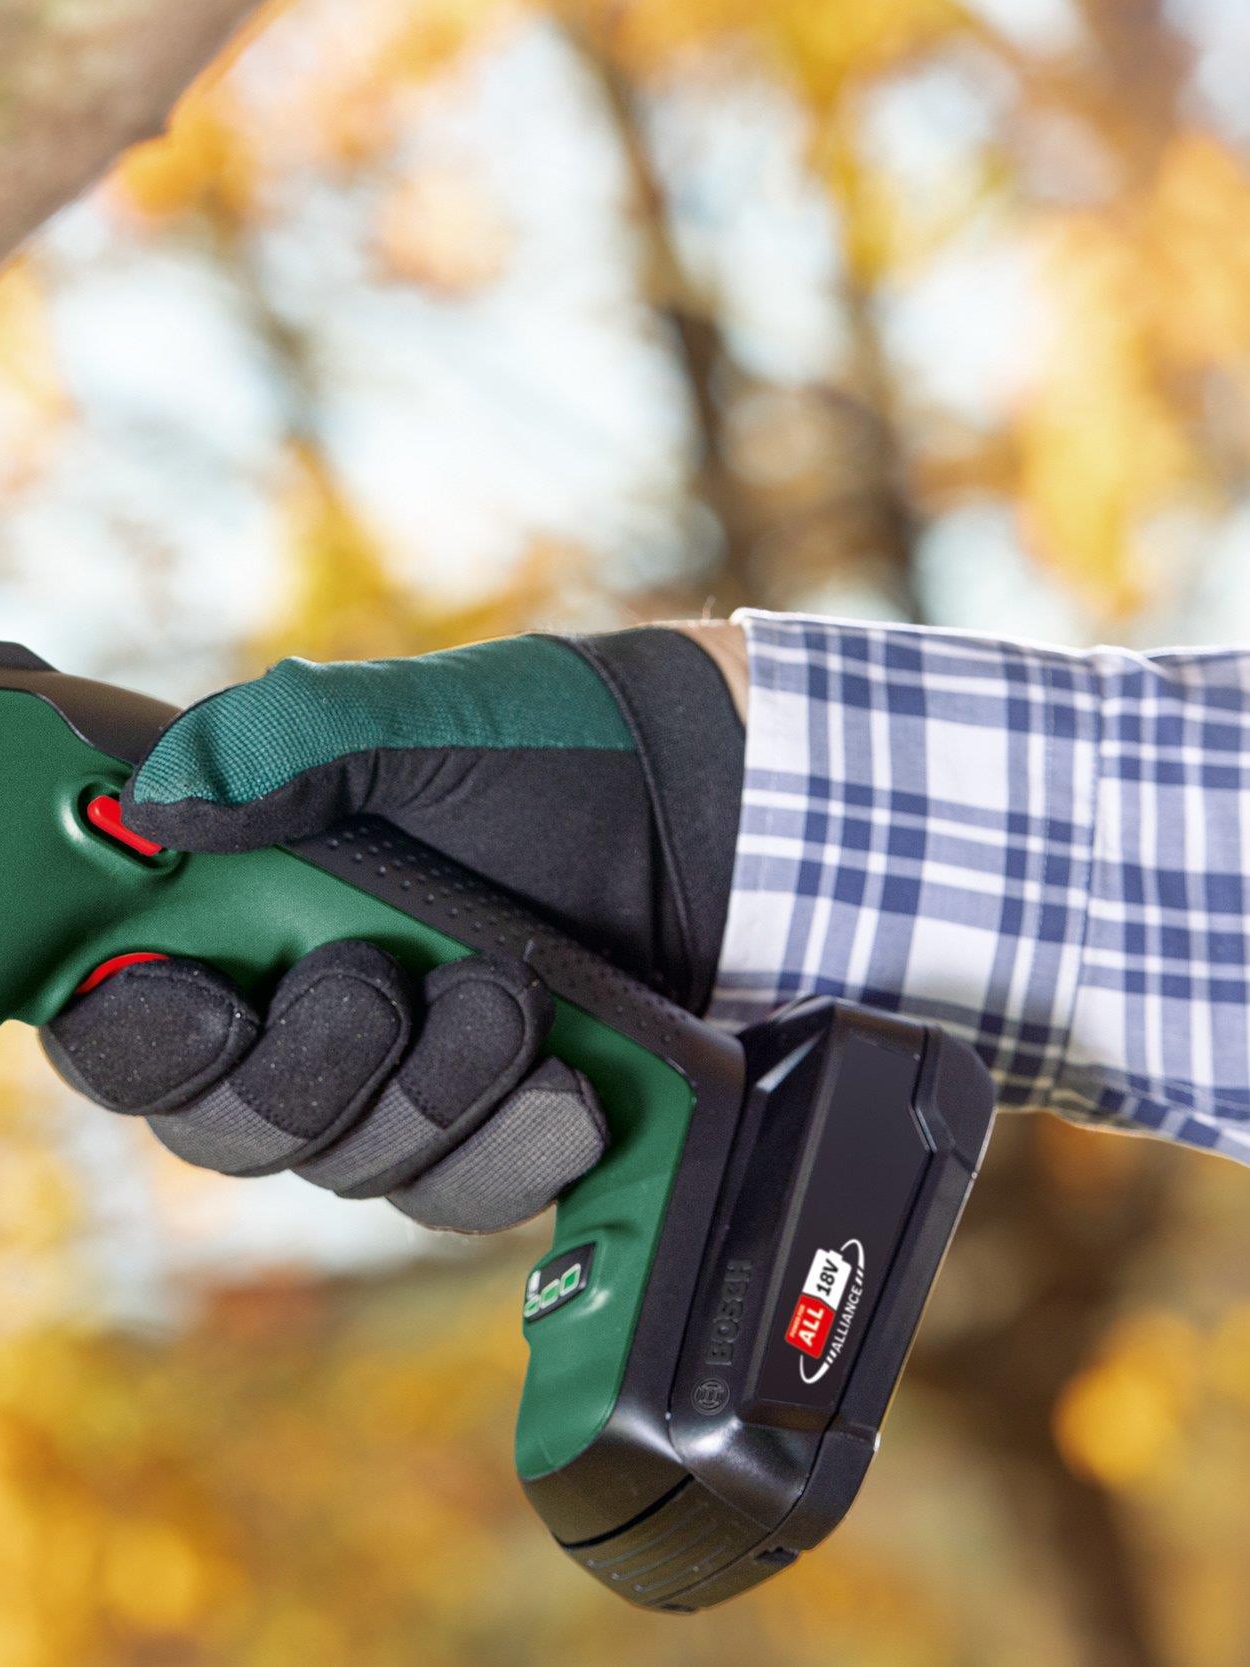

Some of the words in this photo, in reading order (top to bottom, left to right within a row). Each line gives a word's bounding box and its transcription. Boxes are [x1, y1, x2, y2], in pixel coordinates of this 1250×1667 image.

[815, 1258, 839, 1296] 18V
[704, 1259, 752, 1365] BOSCH
[797, 1308, 825, 1347] ALL
[831, 1284, 863, 1353] ALLIANCE
